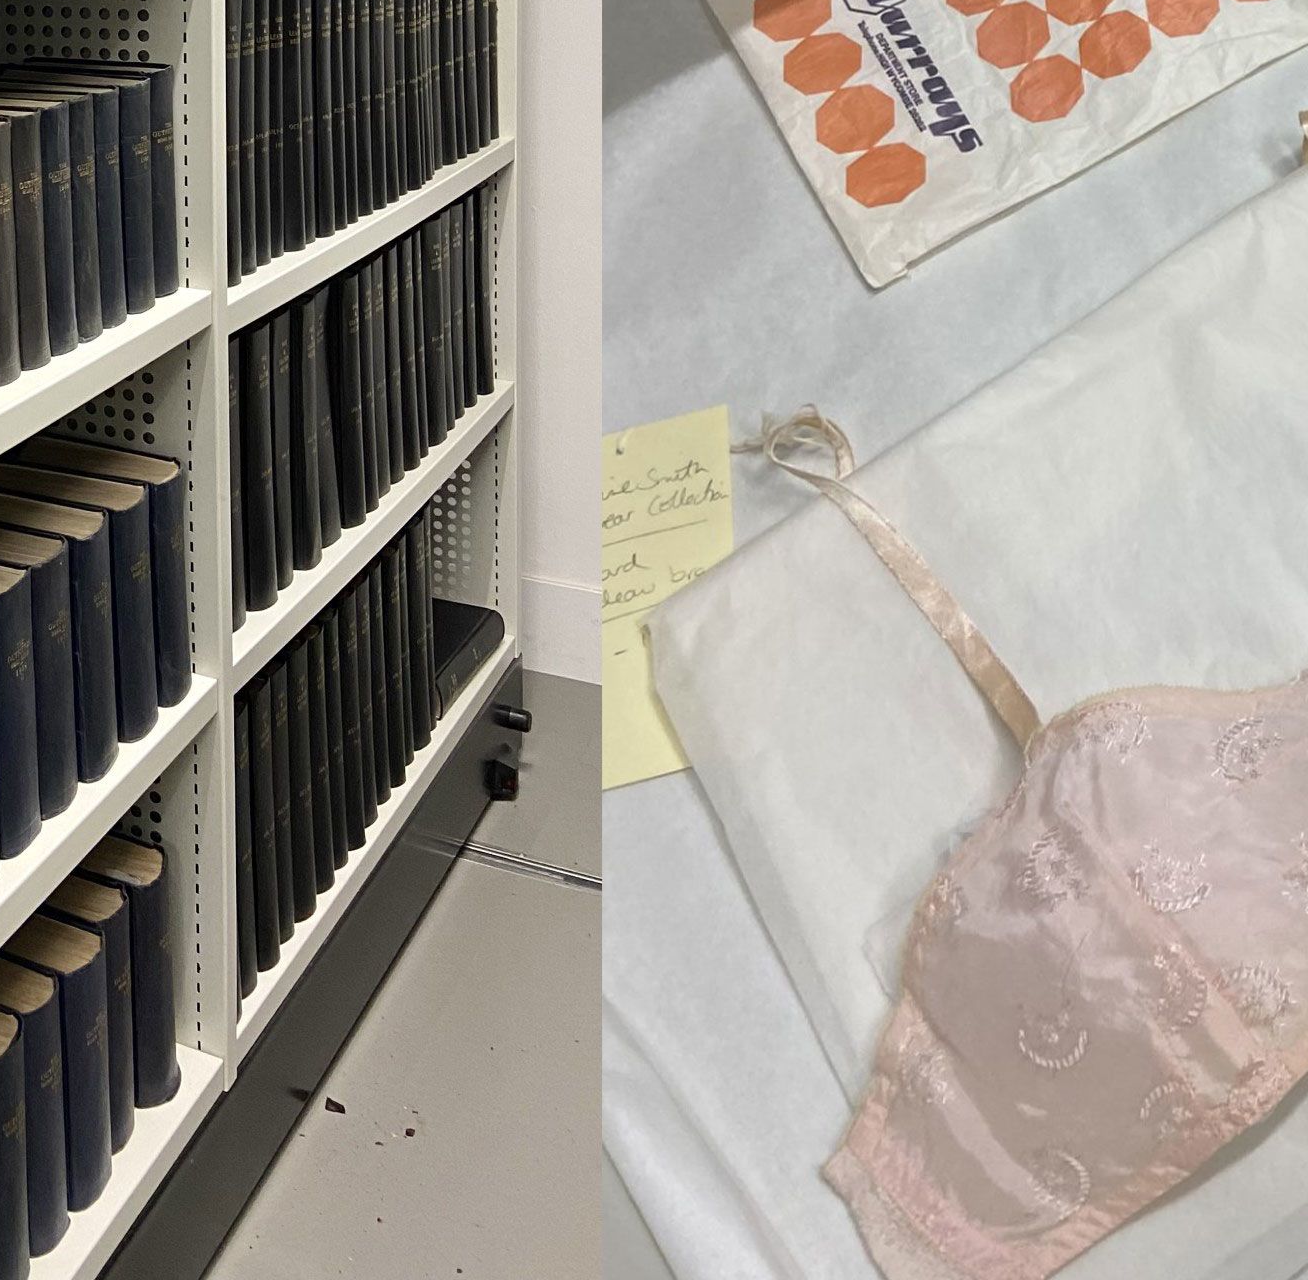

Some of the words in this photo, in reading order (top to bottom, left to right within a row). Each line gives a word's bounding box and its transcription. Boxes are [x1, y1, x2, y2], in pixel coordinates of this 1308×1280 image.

[876, 32, 907, 81] DEPARTMENT
[904, 79, 923, 106] STORE
[886, 68, 913, 109] WYCOMBE
[640, 460, 710, 490] Smith
[648, 479, 729, 516] Collection
